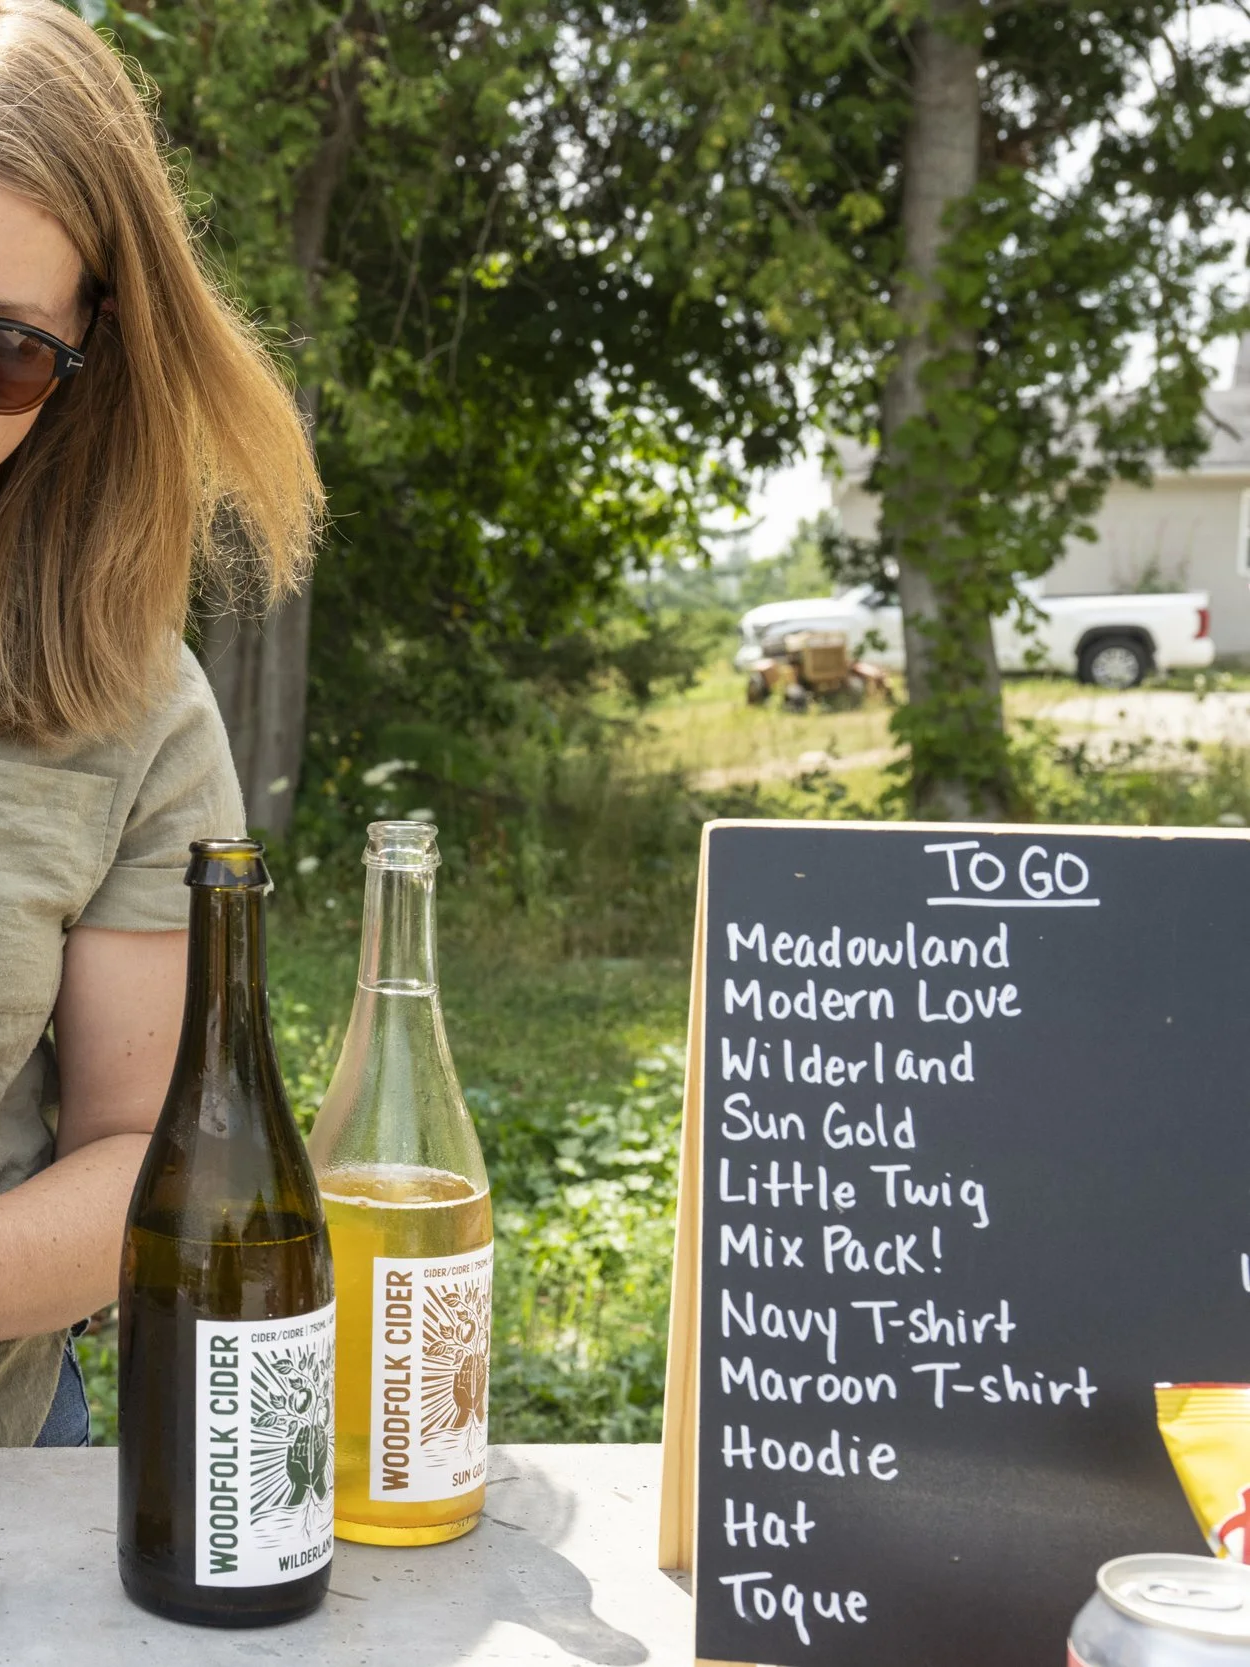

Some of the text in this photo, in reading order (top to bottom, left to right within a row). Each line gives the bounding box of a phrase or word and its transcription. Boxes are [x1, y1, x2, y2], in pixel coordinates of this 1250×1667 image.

[924, 841, 1089, 900] TO GO
[727, 922, 1010, 970] Meadowland
[724, 979, 1022, 1024] Modern Love
[722, 1037, 975, 1087] Wilderland
[722, 1093, 916, 1150] Sun Gold
[720, 1158, 990, 1229] Little Twig
[423, 1263, 470, 1278] CIDER/CIDRE
[721, 1224, 942, 1275] Mix Pack!
[251, 1327, 304, 1343] CIDER/CIDRE
[722, 1289, 1017, 1365] Navy T-shirt
[382, 1270, 412, 1491] WOODFOLK CIDER
[721, 1357, 1098, 1408] Maroon T-shirt
[209, 1335, 239, 1575] WOODFOLK CIDER
[452, 1469, 470, 1487] SUN
[722, 1425, 899, 1481] Hoodie
[724, 1499, 816, 1548] Hat
[719, 1572, 868, 1646] Toque
